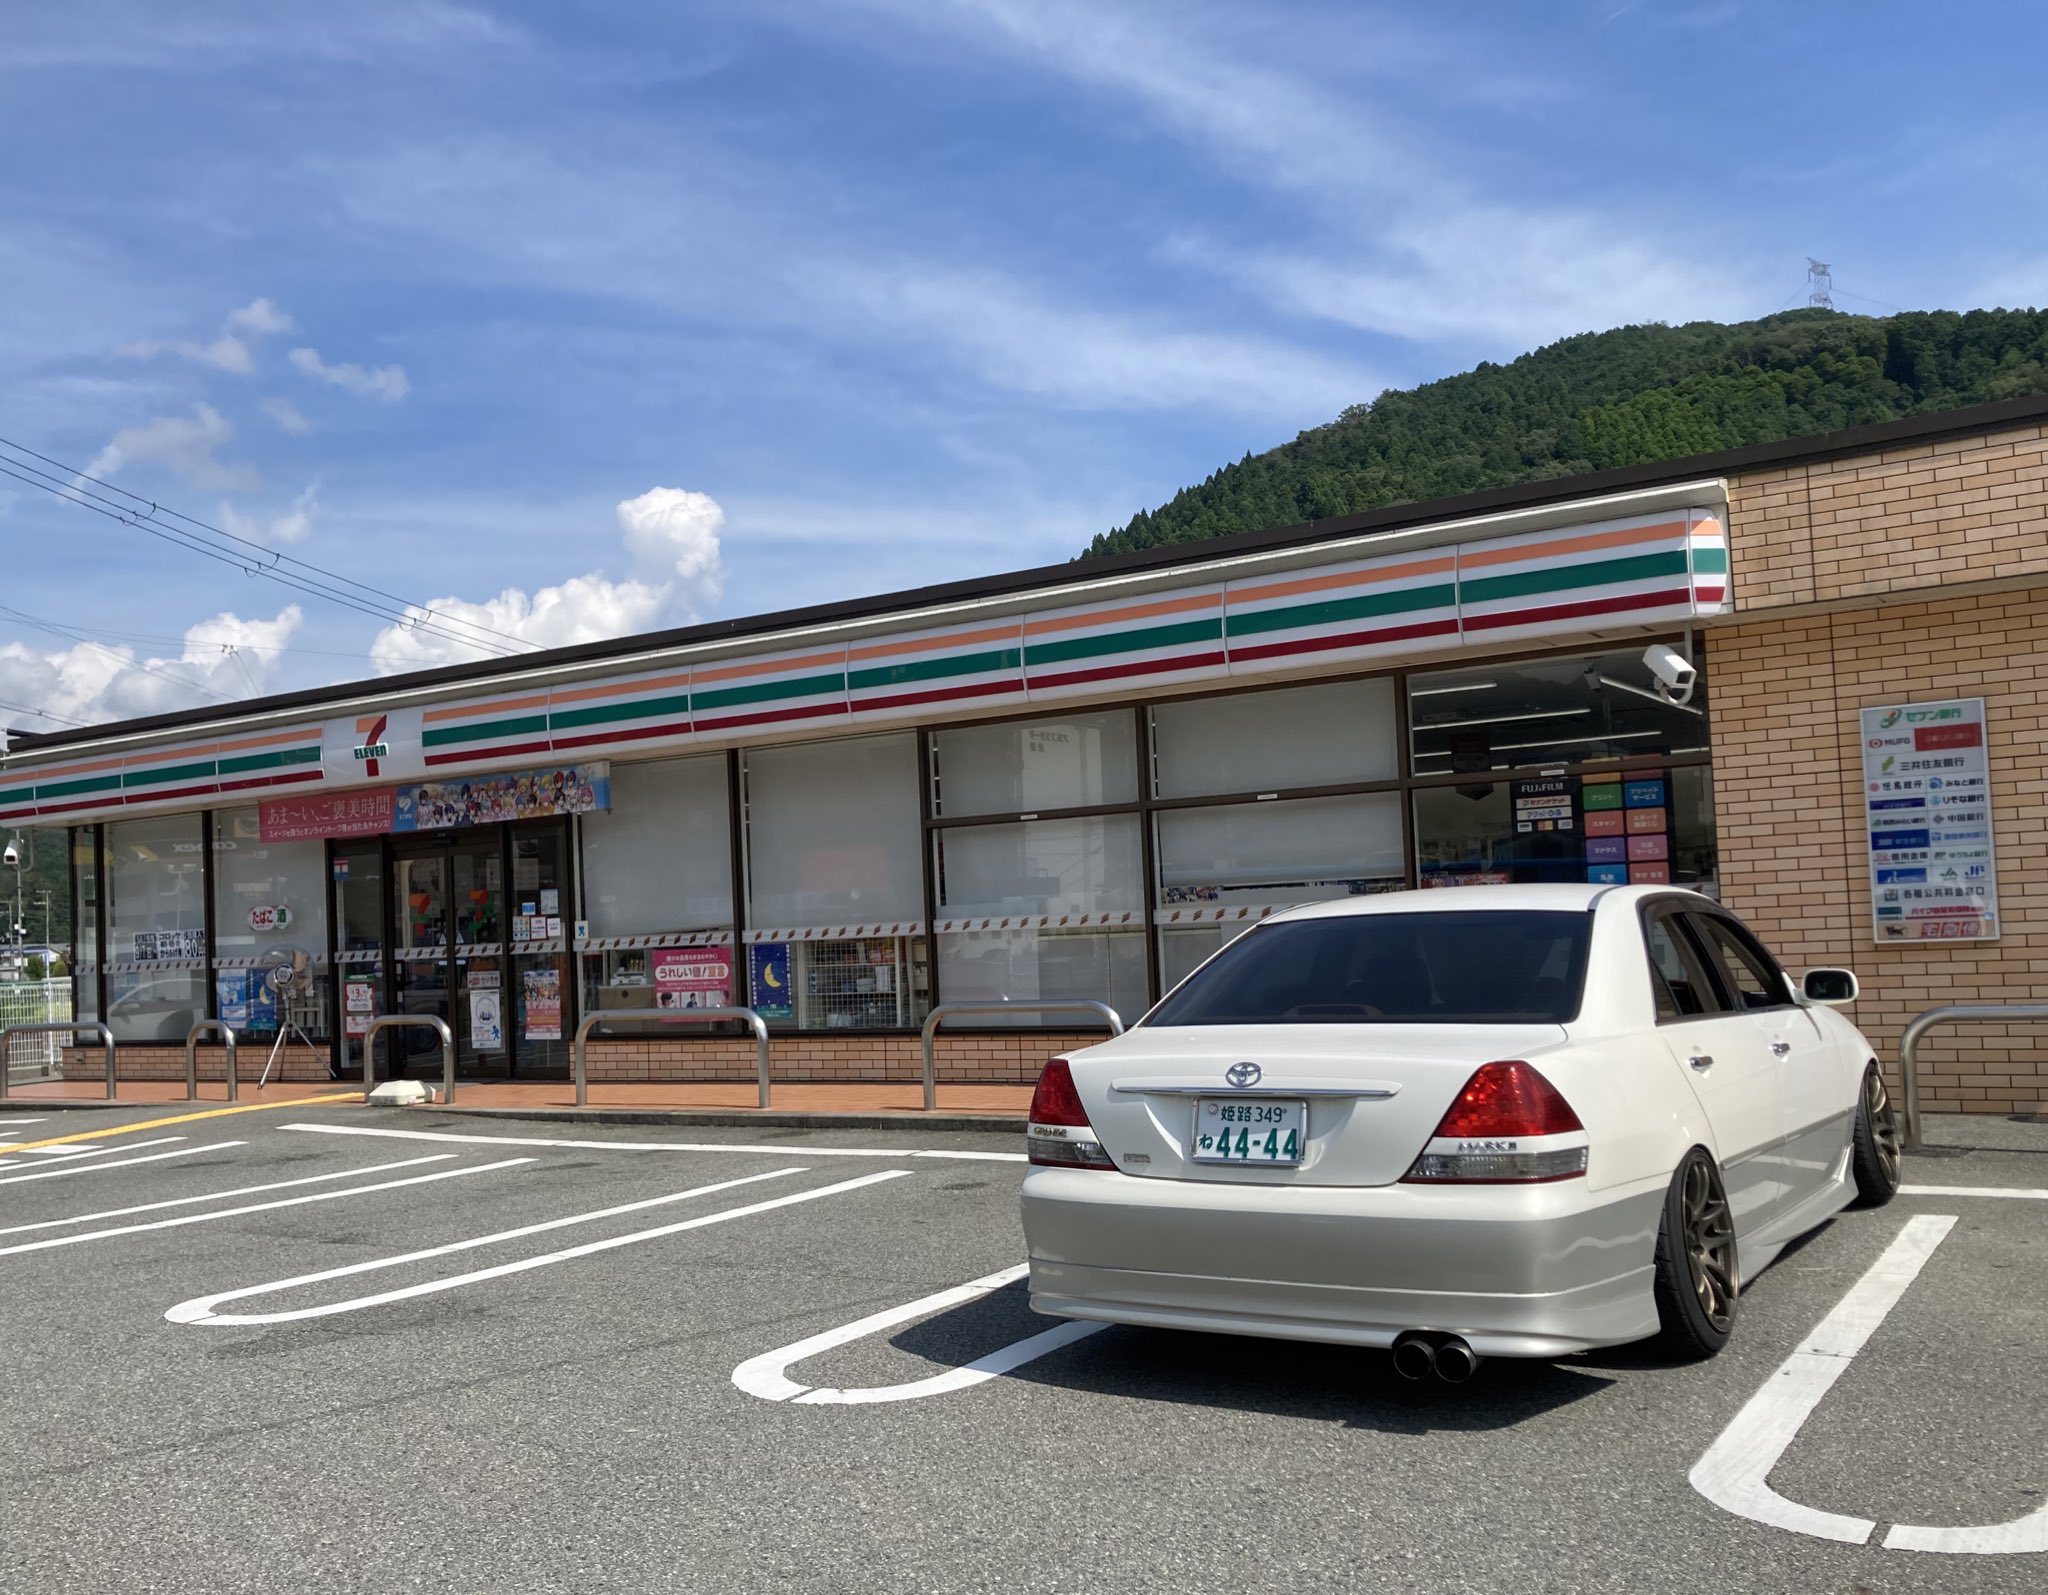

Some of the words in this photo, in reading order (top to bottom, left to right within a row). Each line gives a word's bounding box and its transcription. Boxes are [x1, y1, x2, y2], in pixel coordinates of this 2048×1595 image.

[356, 714, 388, 777] 7
[1885, 738, 1911, 746] MUFG
[1900, 757, 1965, 771] 三井住友銀行
[1882, 780, 1923, 791] 但馬銀行
[1945, 778, 1984, 788] みなと銀行
[1943, 794, 1985, 804] りそな銀行
[1947, 813, 1984, 823] 中国銀行
[1891, 851, 1928, 861] 信用金庫
[1904, 886, 1985, 899] 各種公共料金窓口
[252, 909, 273, 925] たばこ
[276, 908, 287, 923] 酒
[1920, 921, 1979, 938] 宅急便
[1221, 1106, 1251, 1122] 姫路
[1255, 1107, 1283, 1122] 349
[1199, 1134, 1213, 1150] ね
[1216, 1127, 1298, 1159] 44-44
[1458, 1141, 1508, 1151] MARK
